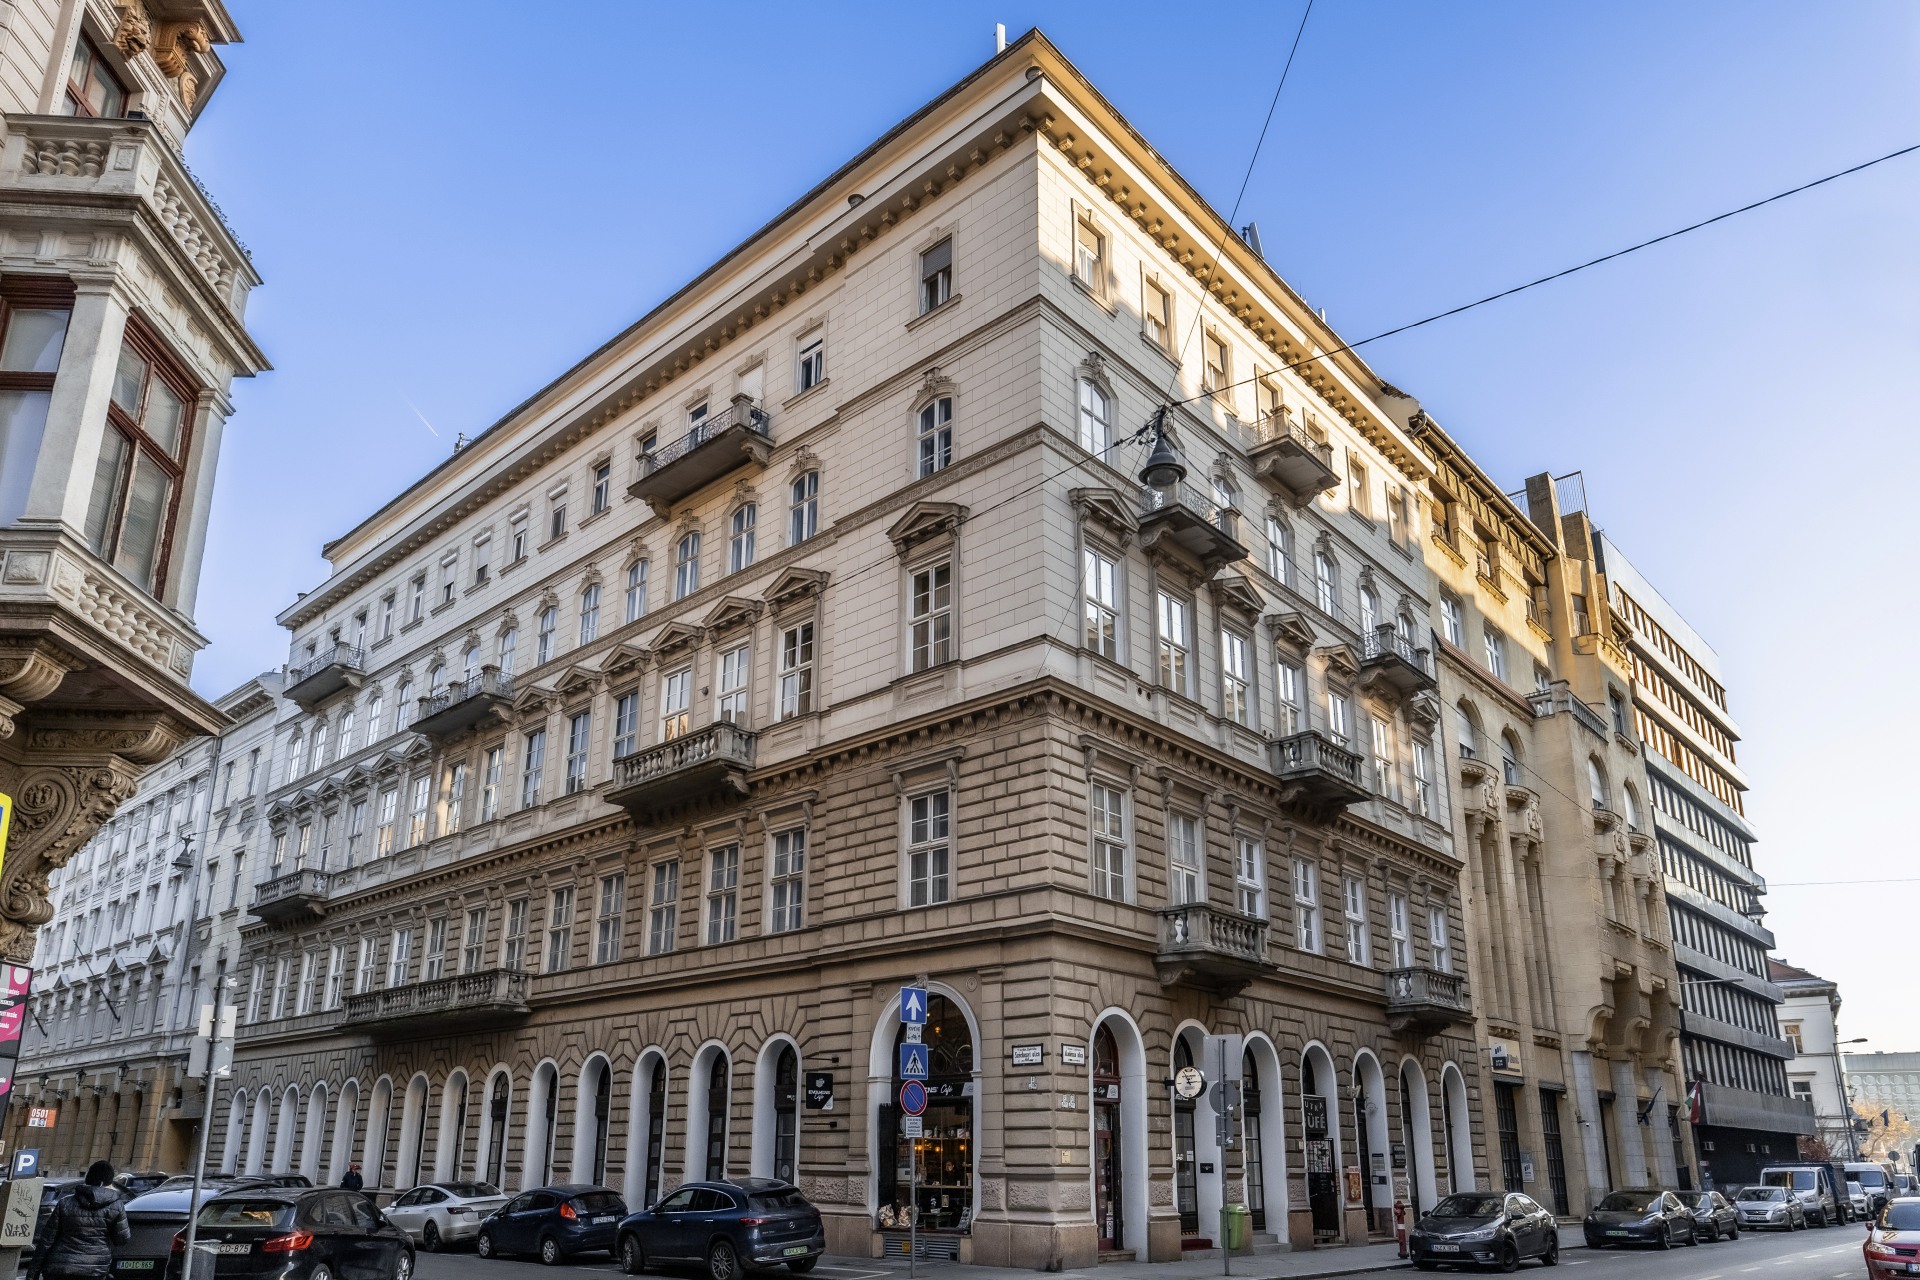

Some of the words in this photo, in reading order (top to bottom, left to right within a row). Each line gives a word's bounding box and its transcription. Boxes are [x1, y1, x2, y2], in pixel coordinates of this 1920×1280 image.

[1304, 1101, 1323, 1111] UTKA
[31, 1108, 49, 1118] 0501
[17, 1154, 35, 1172] P
